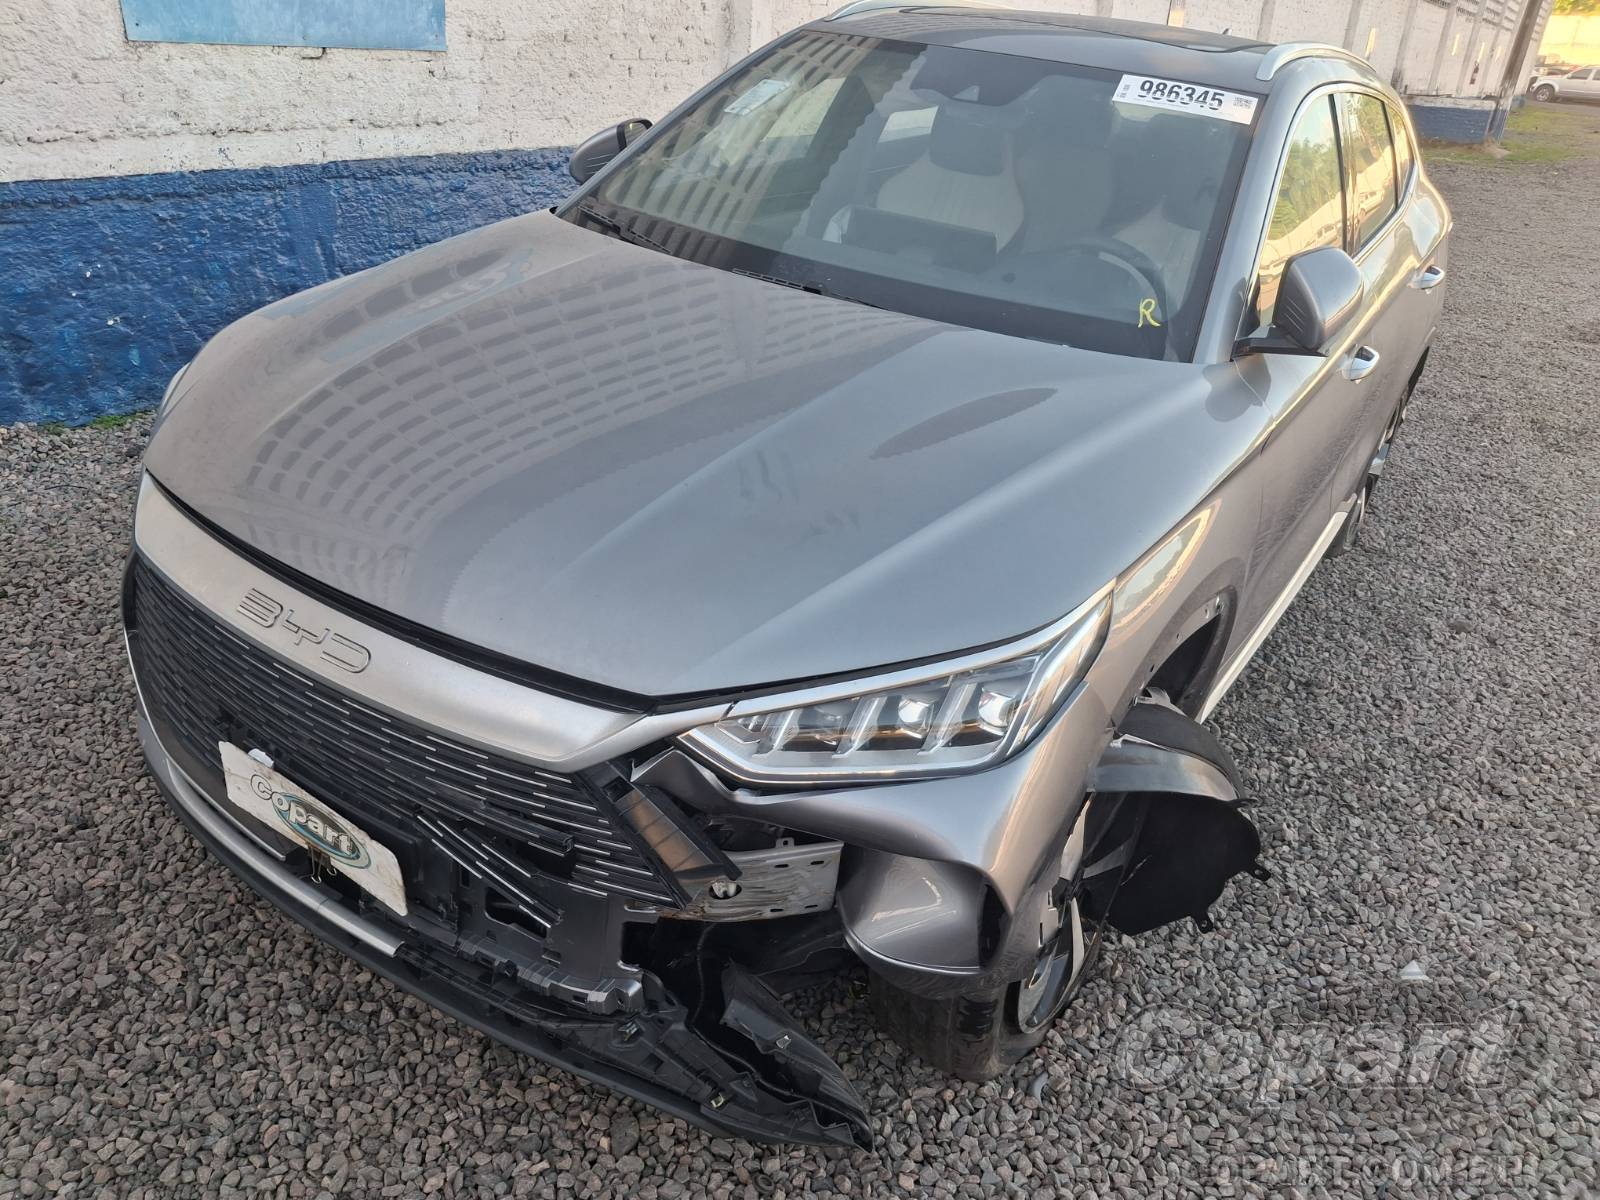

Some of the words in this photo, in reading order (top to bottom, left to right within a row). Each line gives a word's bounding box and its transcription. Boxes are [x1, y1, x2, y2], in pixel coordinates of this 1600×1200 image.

[1137, 80, 1225, 111] 986345
[1137, 297, 1161, 329] R
[236, 587, 371, 674] BYD
[250, 774, 354, 856] Copart
